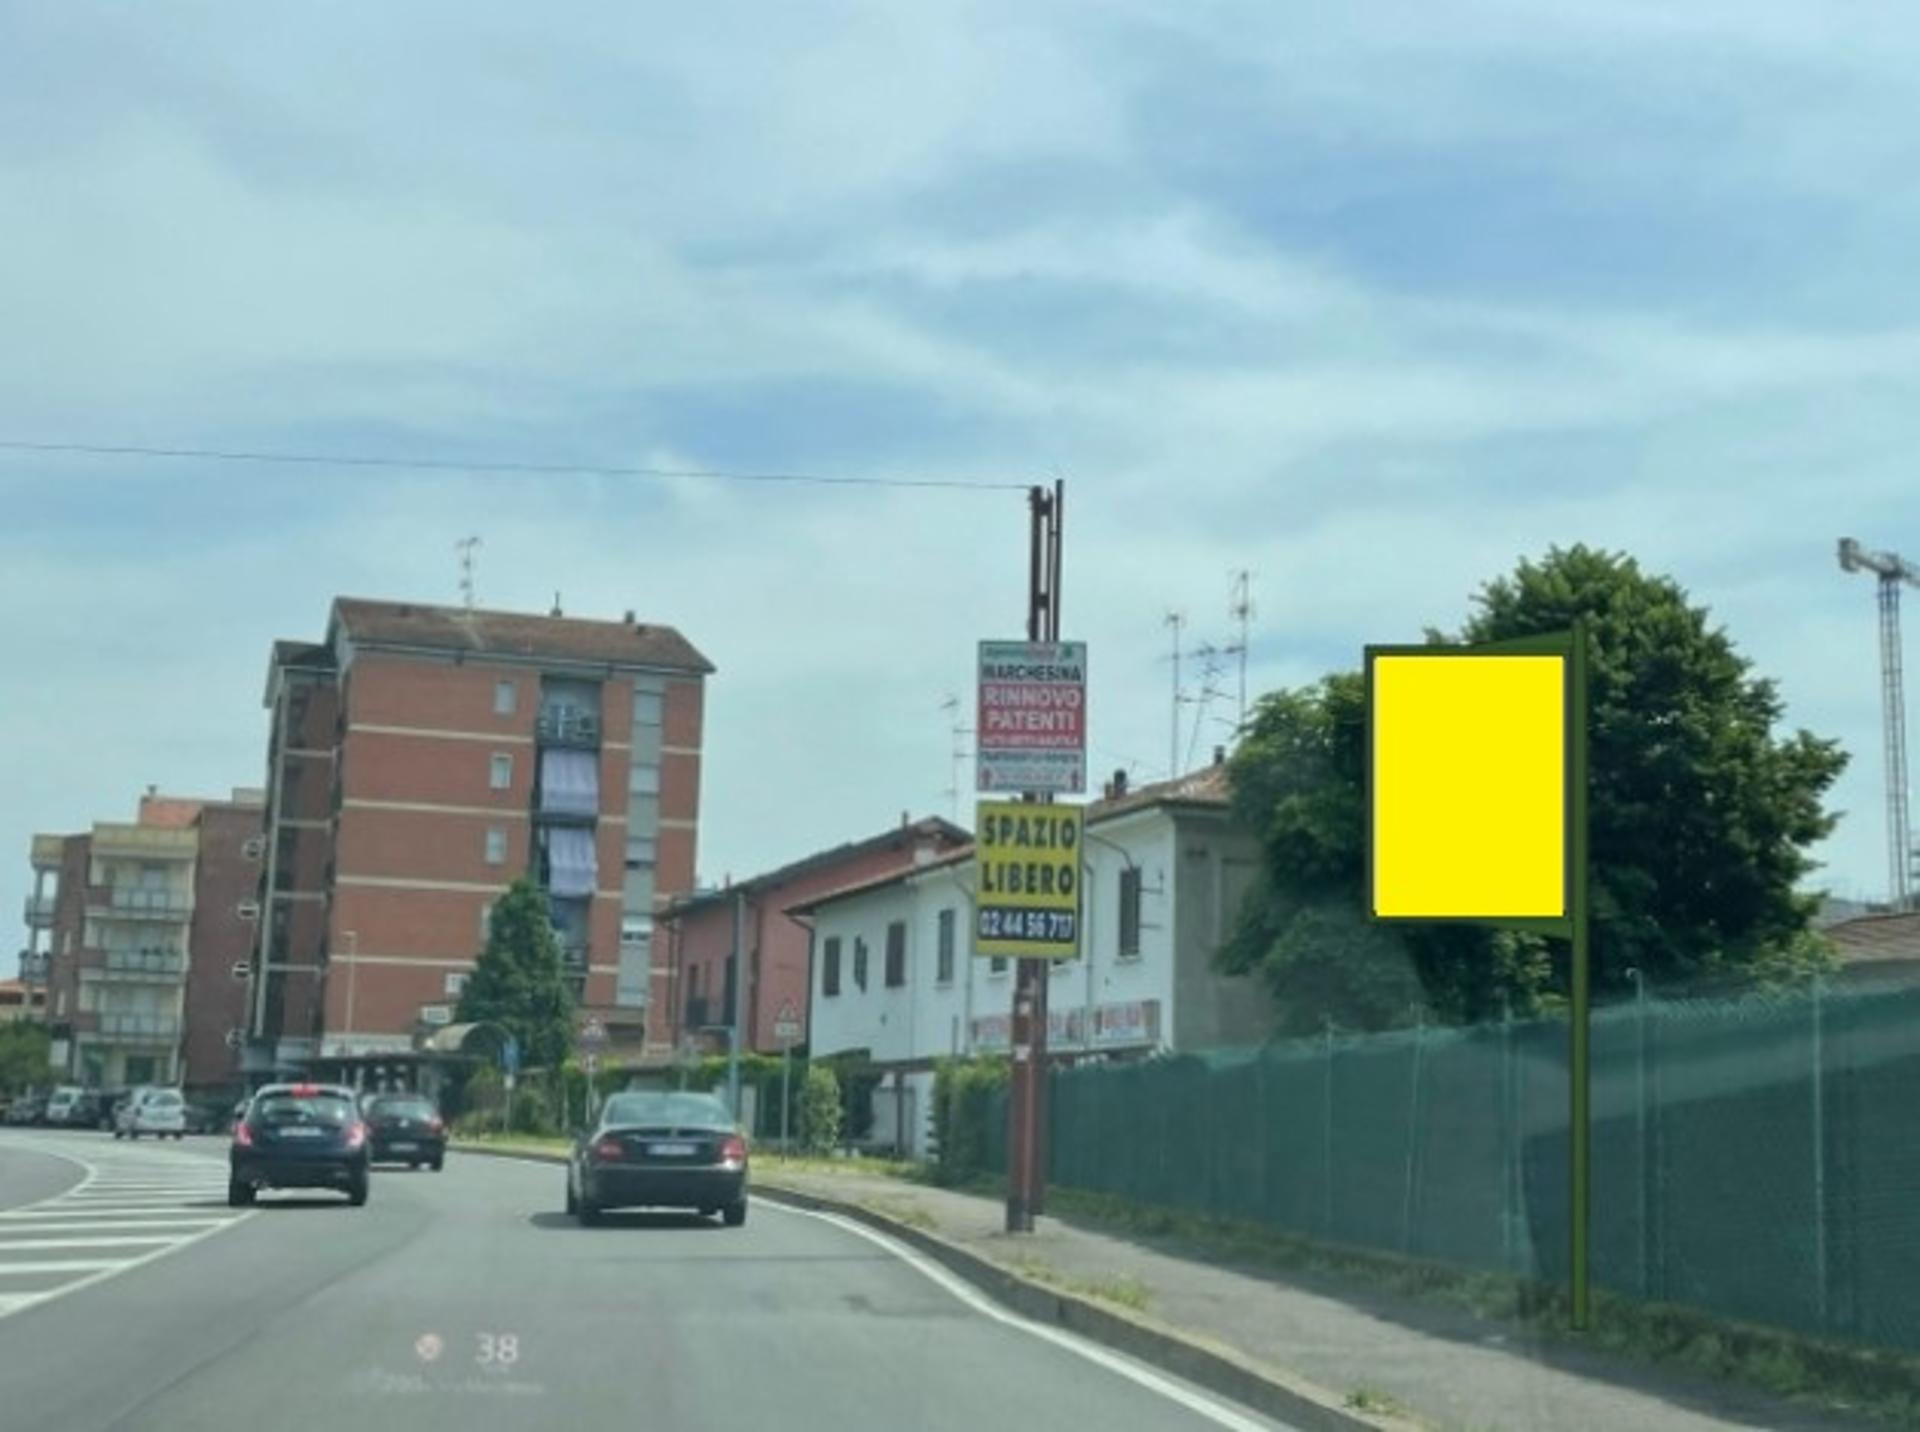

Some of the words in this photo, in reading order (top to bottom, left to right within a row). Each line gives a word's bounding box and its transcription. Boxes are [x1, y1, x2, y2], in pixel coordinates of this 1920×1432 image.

[984, 687, 1081, 707] RINNOVO
[986, 710, 1076, 730] PATENTI
[982, 815, 1076, 849] SPAZIO
[981, 861, 1075, 895] LIBERO
[981, 910, 1001, 936] 02
[1002, 911, 1023, 937] 44
[475, 1333, 519, 1364] 38
